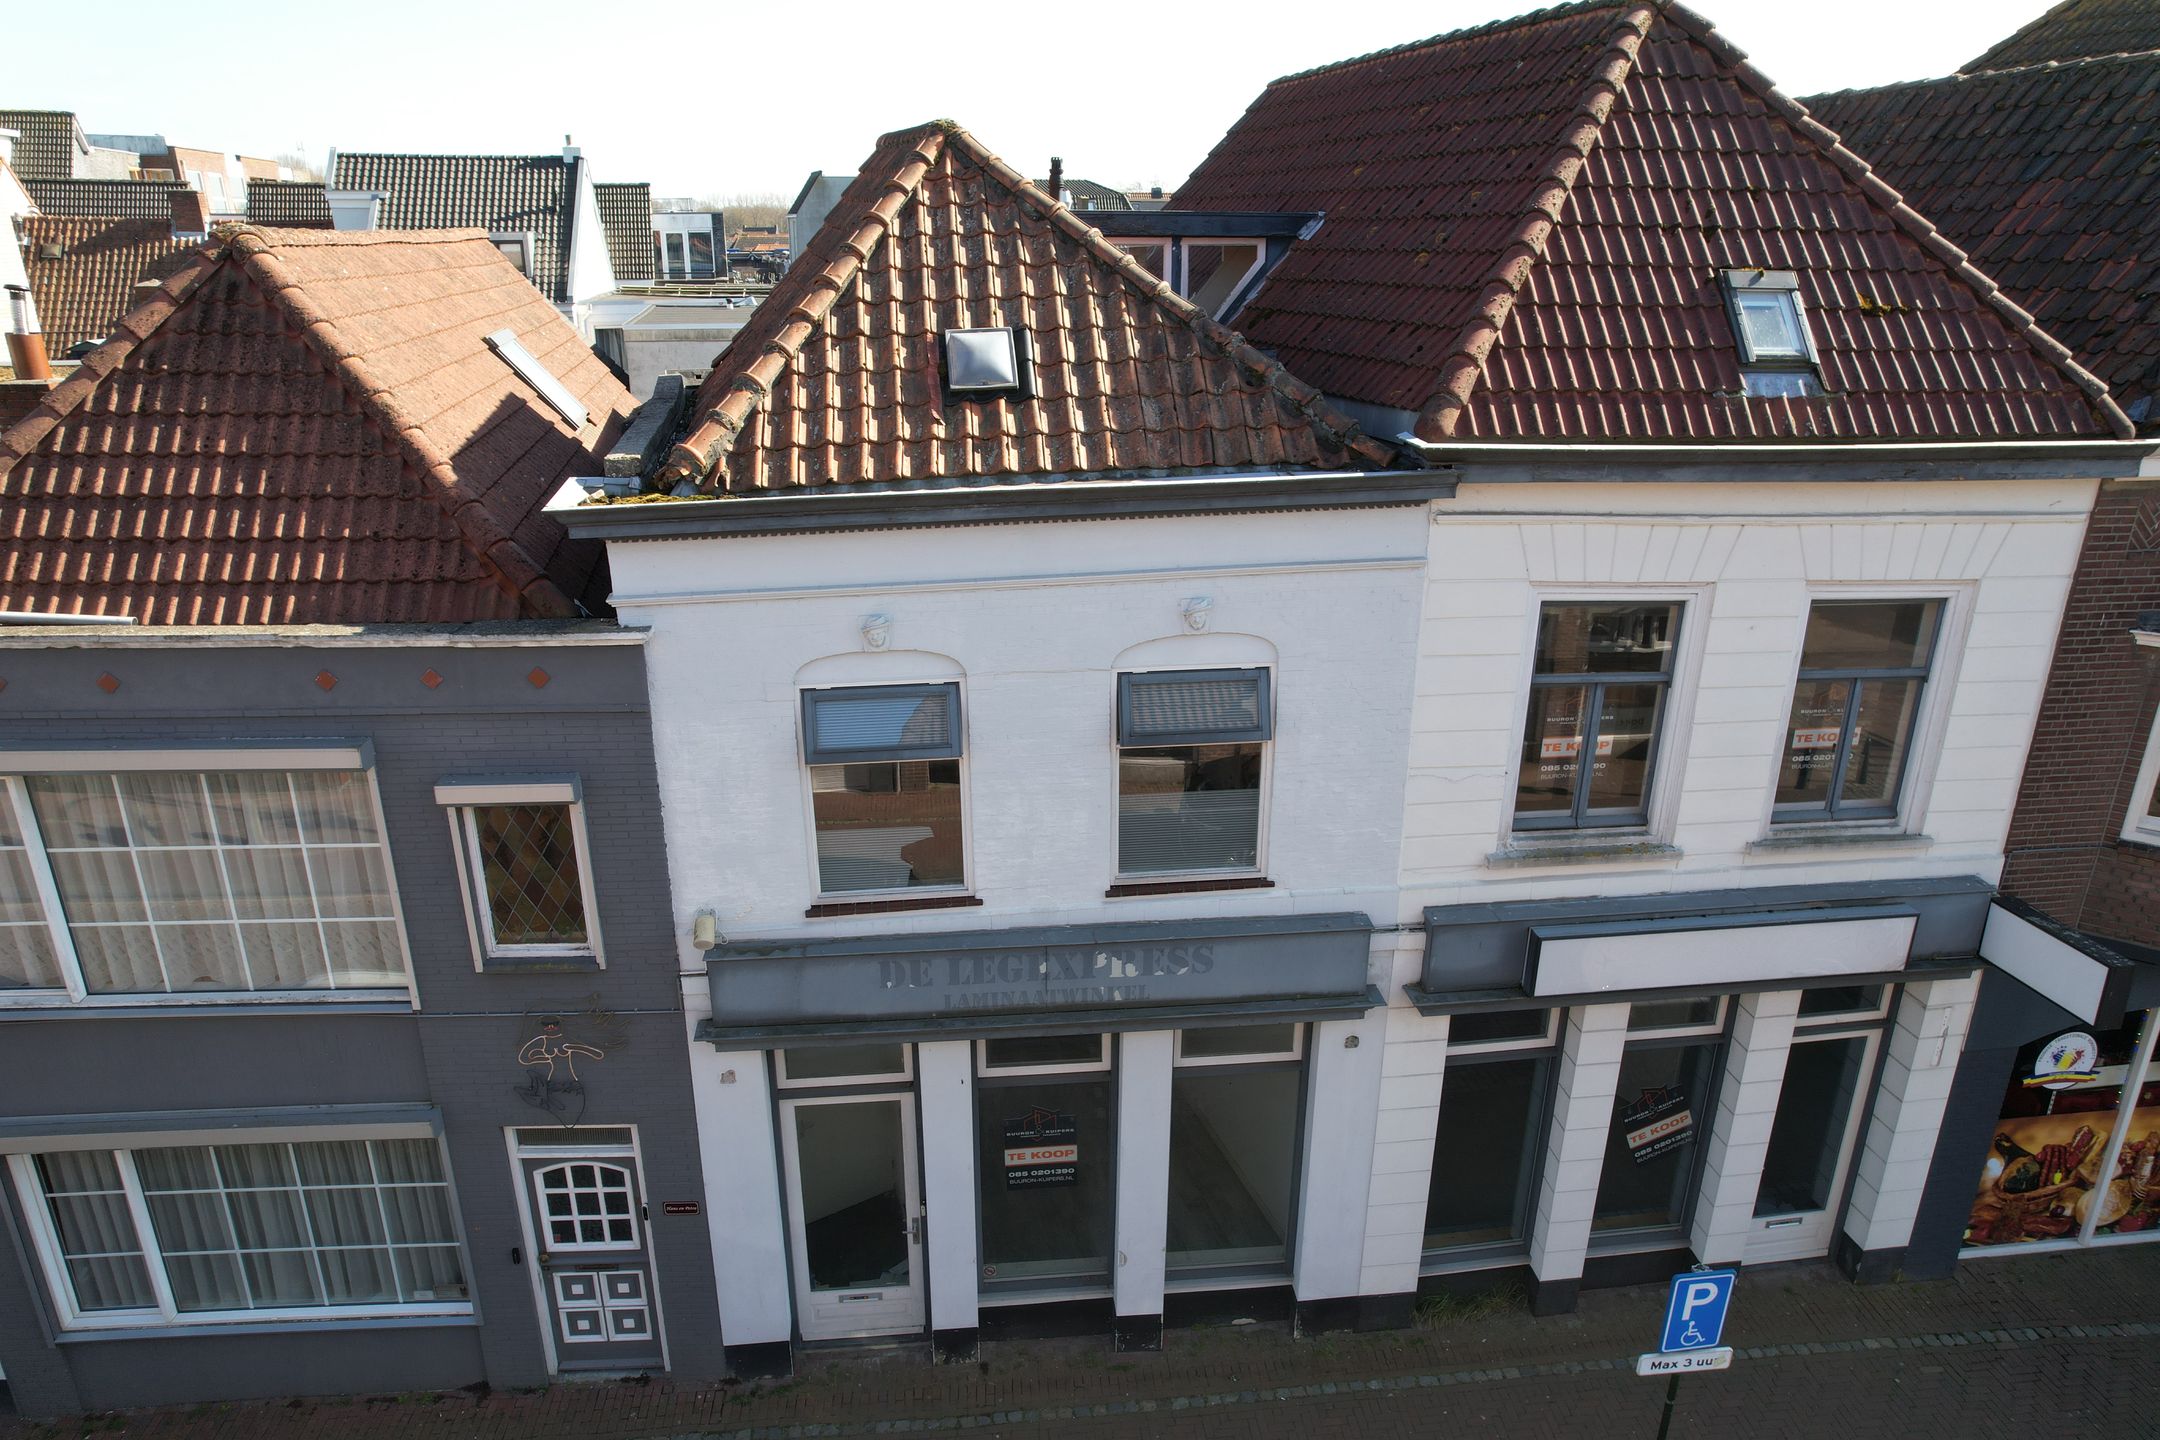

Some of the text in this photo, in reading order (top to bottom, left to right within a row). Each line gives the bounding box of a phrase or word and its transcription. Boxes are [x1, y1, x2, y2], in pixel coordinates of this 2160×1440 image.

[1796, 732, 1858, 743] TE KO
[1544, 741, 1610, 752] TE KP
[1563, 762, 1606, 771] 0290
[878, 958, 933, 989] DE
[1630, 1132, 1647, 1143] TE
[1650, 1114, 1689, 1136] KOOP
[1008, 1150, 1075, 1161] TE KOOP
[1031, 1168, 1075, 1176] 0201390
[1681, 1282, 1718, 1320] P
[1650, 1360, 1678, 1370] Max
[1683, 1358, 1692, 1367] 3
